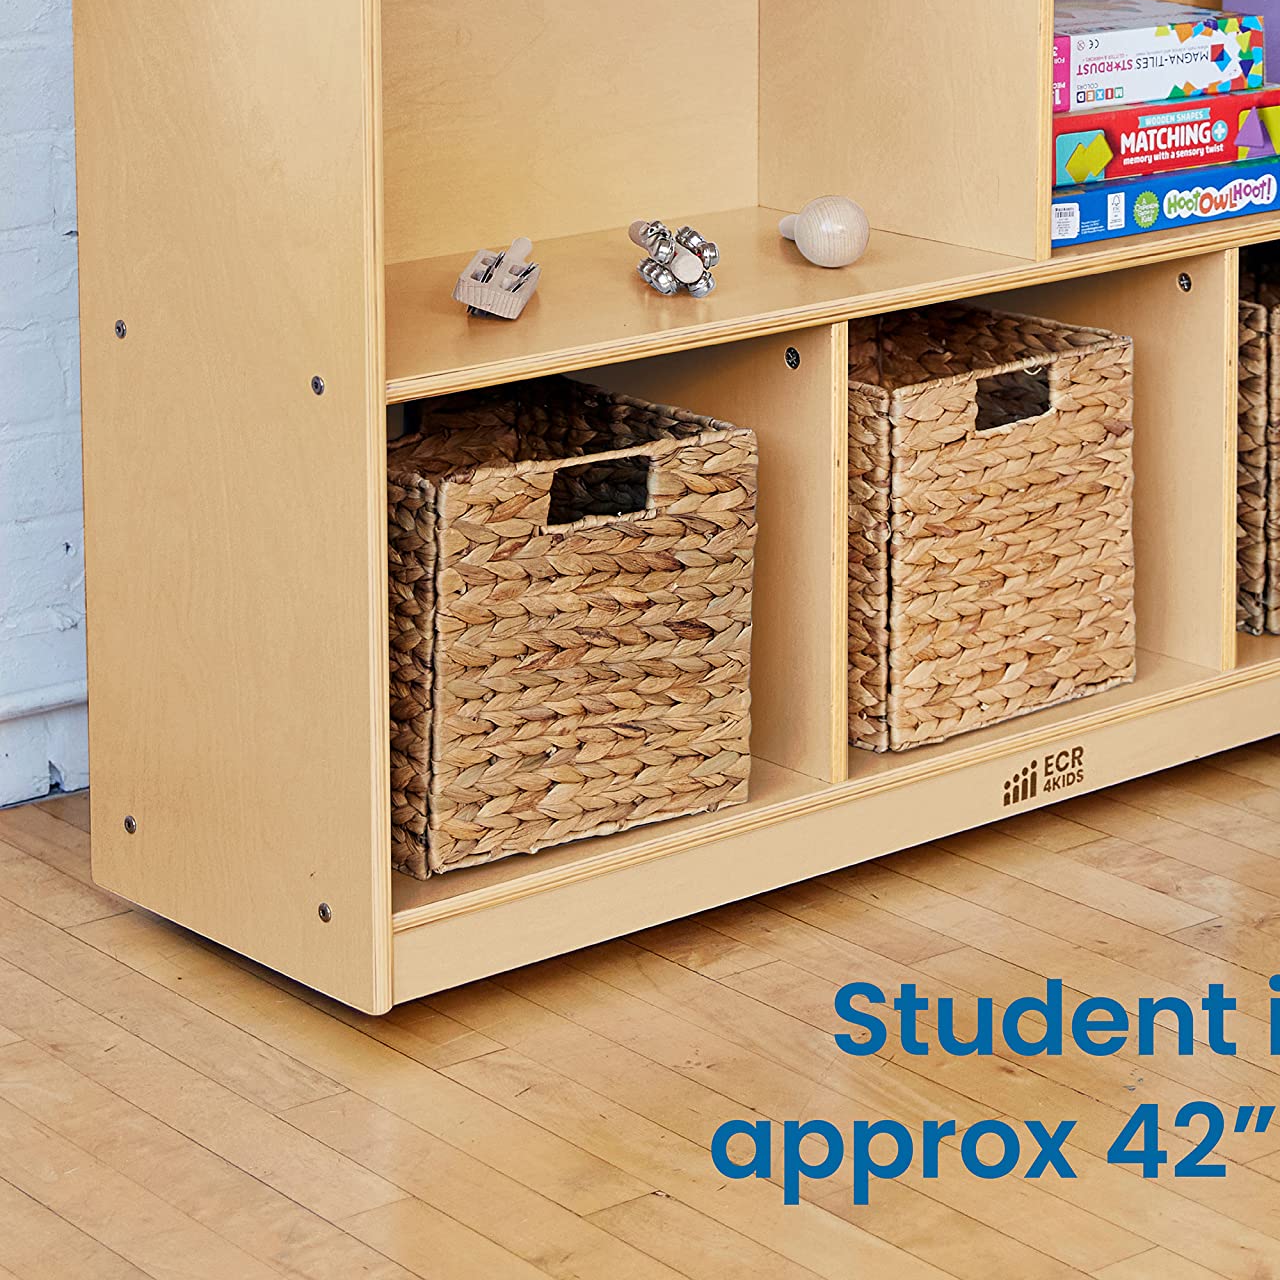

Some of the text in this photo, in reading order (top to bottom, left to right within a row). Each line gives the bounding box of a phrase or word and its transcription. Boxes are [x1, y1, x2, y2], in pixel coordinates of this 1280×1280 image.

[1136, 51, 1210, 69] MAGNA-TILES
[1077, 87, 1124, 104] MIXED
[1144, 110, 1204, 126] WOODEN SHAPES
[1123, 154, 1153, 165] memory
[1153, 151, 1169, 161] with
[1176, 146, 1205, 158] sensory
[1205, 143, 1225, 154] twist
[1044, 745, 1084, 777] ECR
[1043, 769, 1084, 793] 4KIDS
